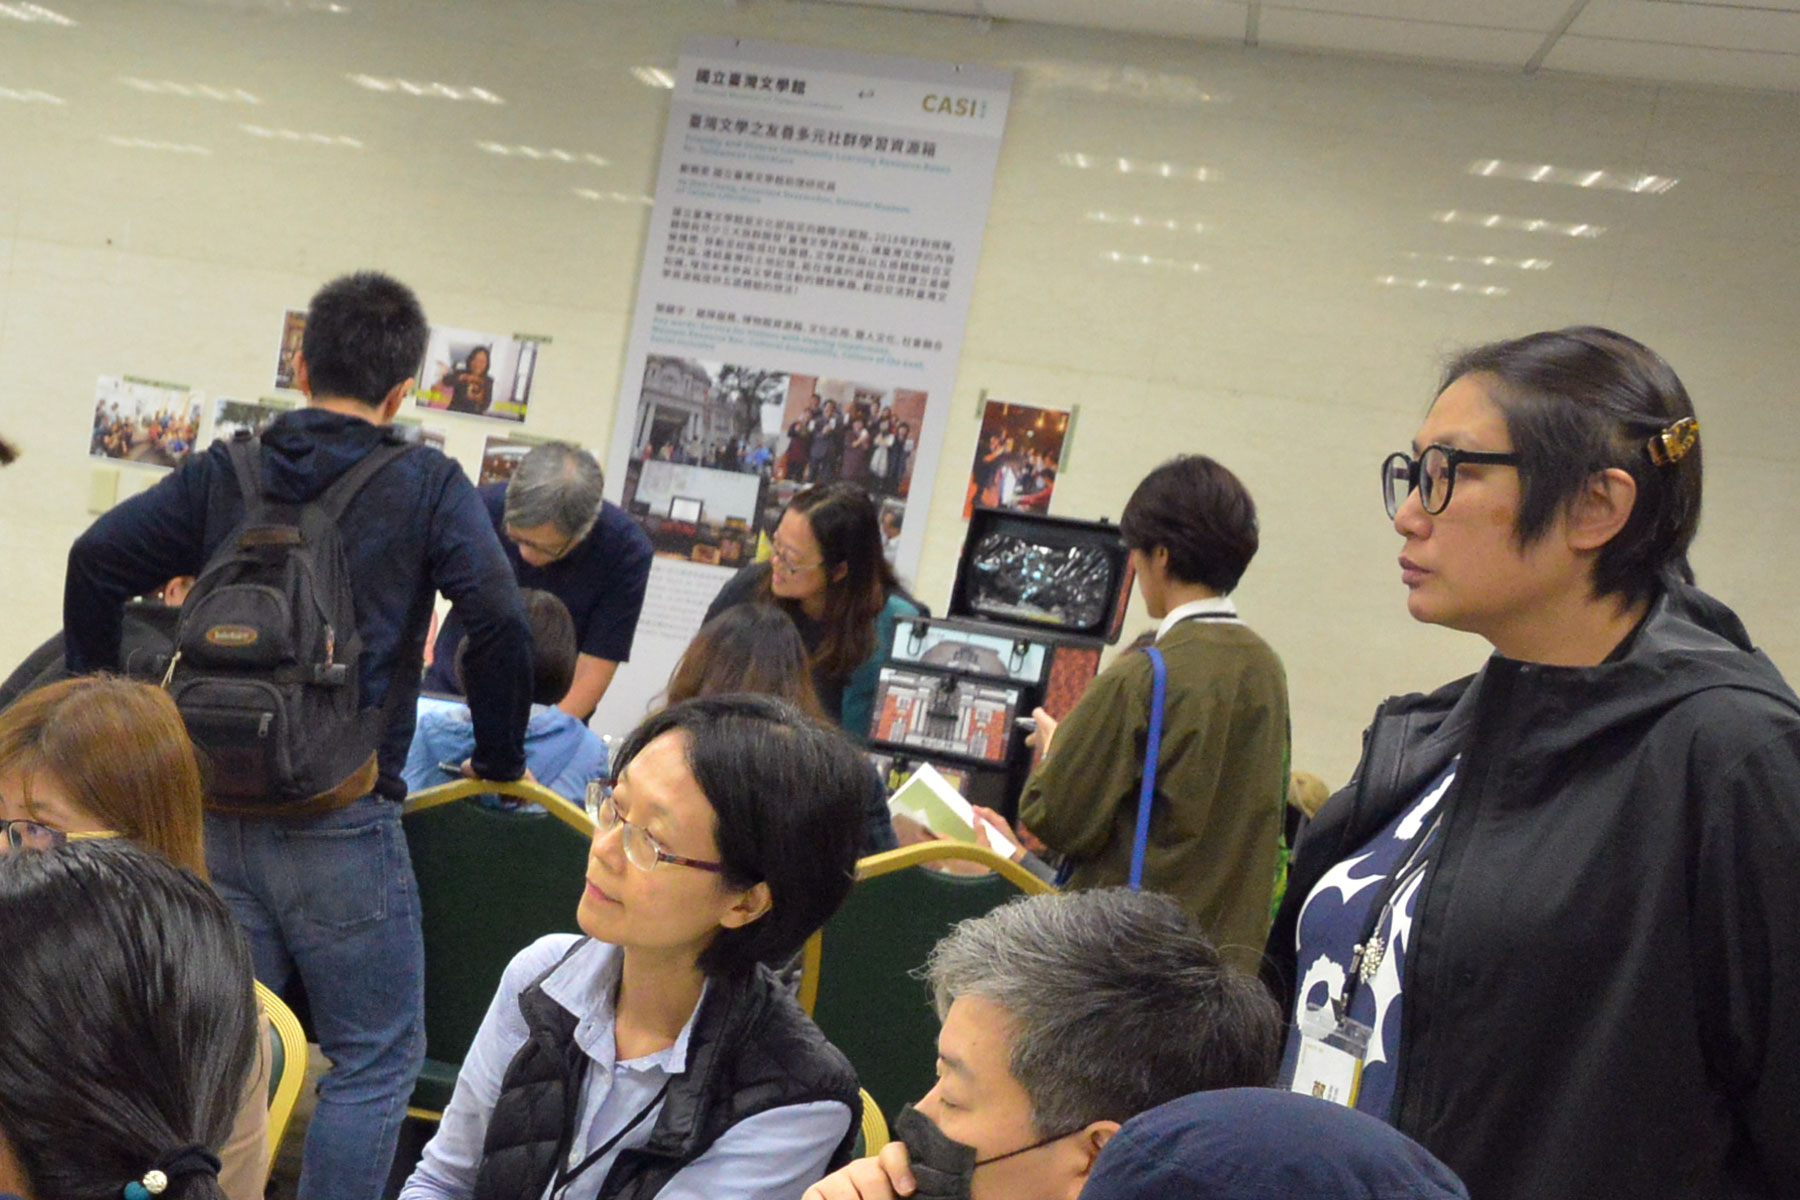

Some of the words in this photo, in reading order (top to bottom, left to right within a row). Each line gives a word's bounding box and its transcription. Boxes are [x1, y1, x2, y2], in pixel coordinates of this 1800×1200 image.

[695, 68, 807, 96] 國立臺灣文學館
